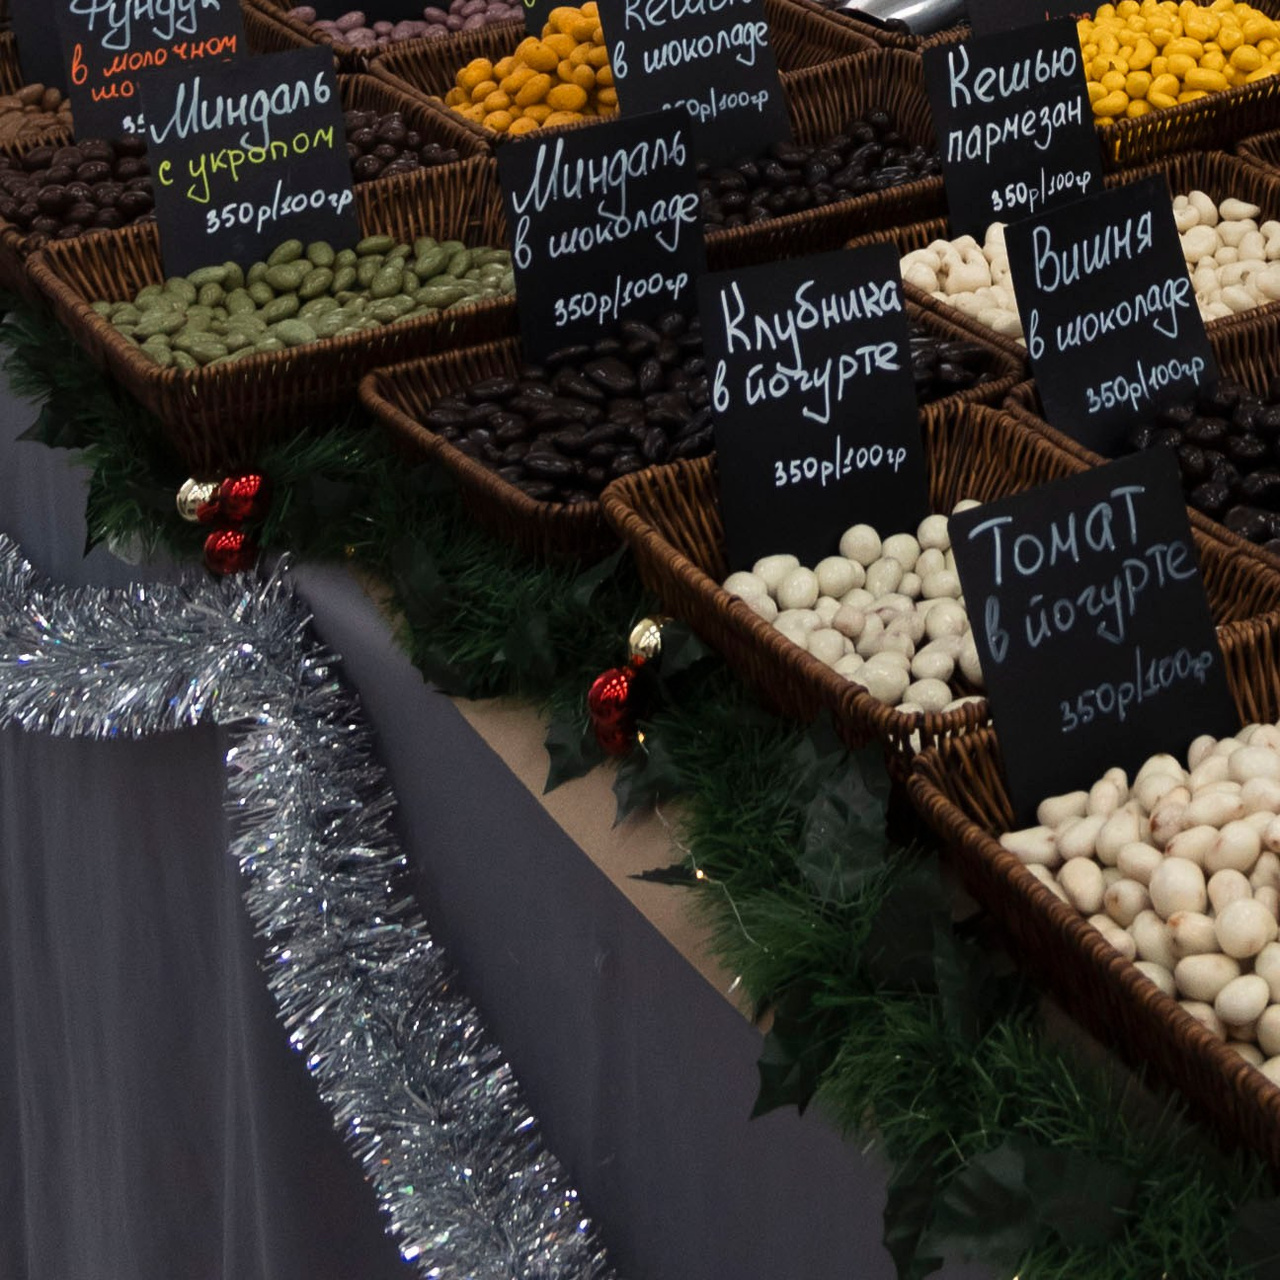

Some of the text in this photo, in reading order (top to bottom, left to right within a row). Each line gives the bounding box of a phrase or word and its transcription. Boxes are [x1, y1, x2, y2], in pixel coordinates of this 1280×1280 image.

[71, 34, 237, 85] в молочном
[613, 21, 769, 79] в шоколаде
[948, 44, 1076, 108] Кешью
[149, 71, 331, 151] Миндаль
[948, 95, 1082, 164] пармезан
[159, 126, 334, 203] с укропом
[512, 130, 686, 220] Миндаль
[514, 193, 699, 270] в шоколаде
[1032, 211, 1153, 293] Вишня
[721, 280, 901, 376] Клубника
[1029, 277, 1190, 360] в шоколаде
[713, 341, 899, 424] в йогурте
[968, 485, 1146, 586] Томат
[985, 540, 1197, 663] в йогурте
